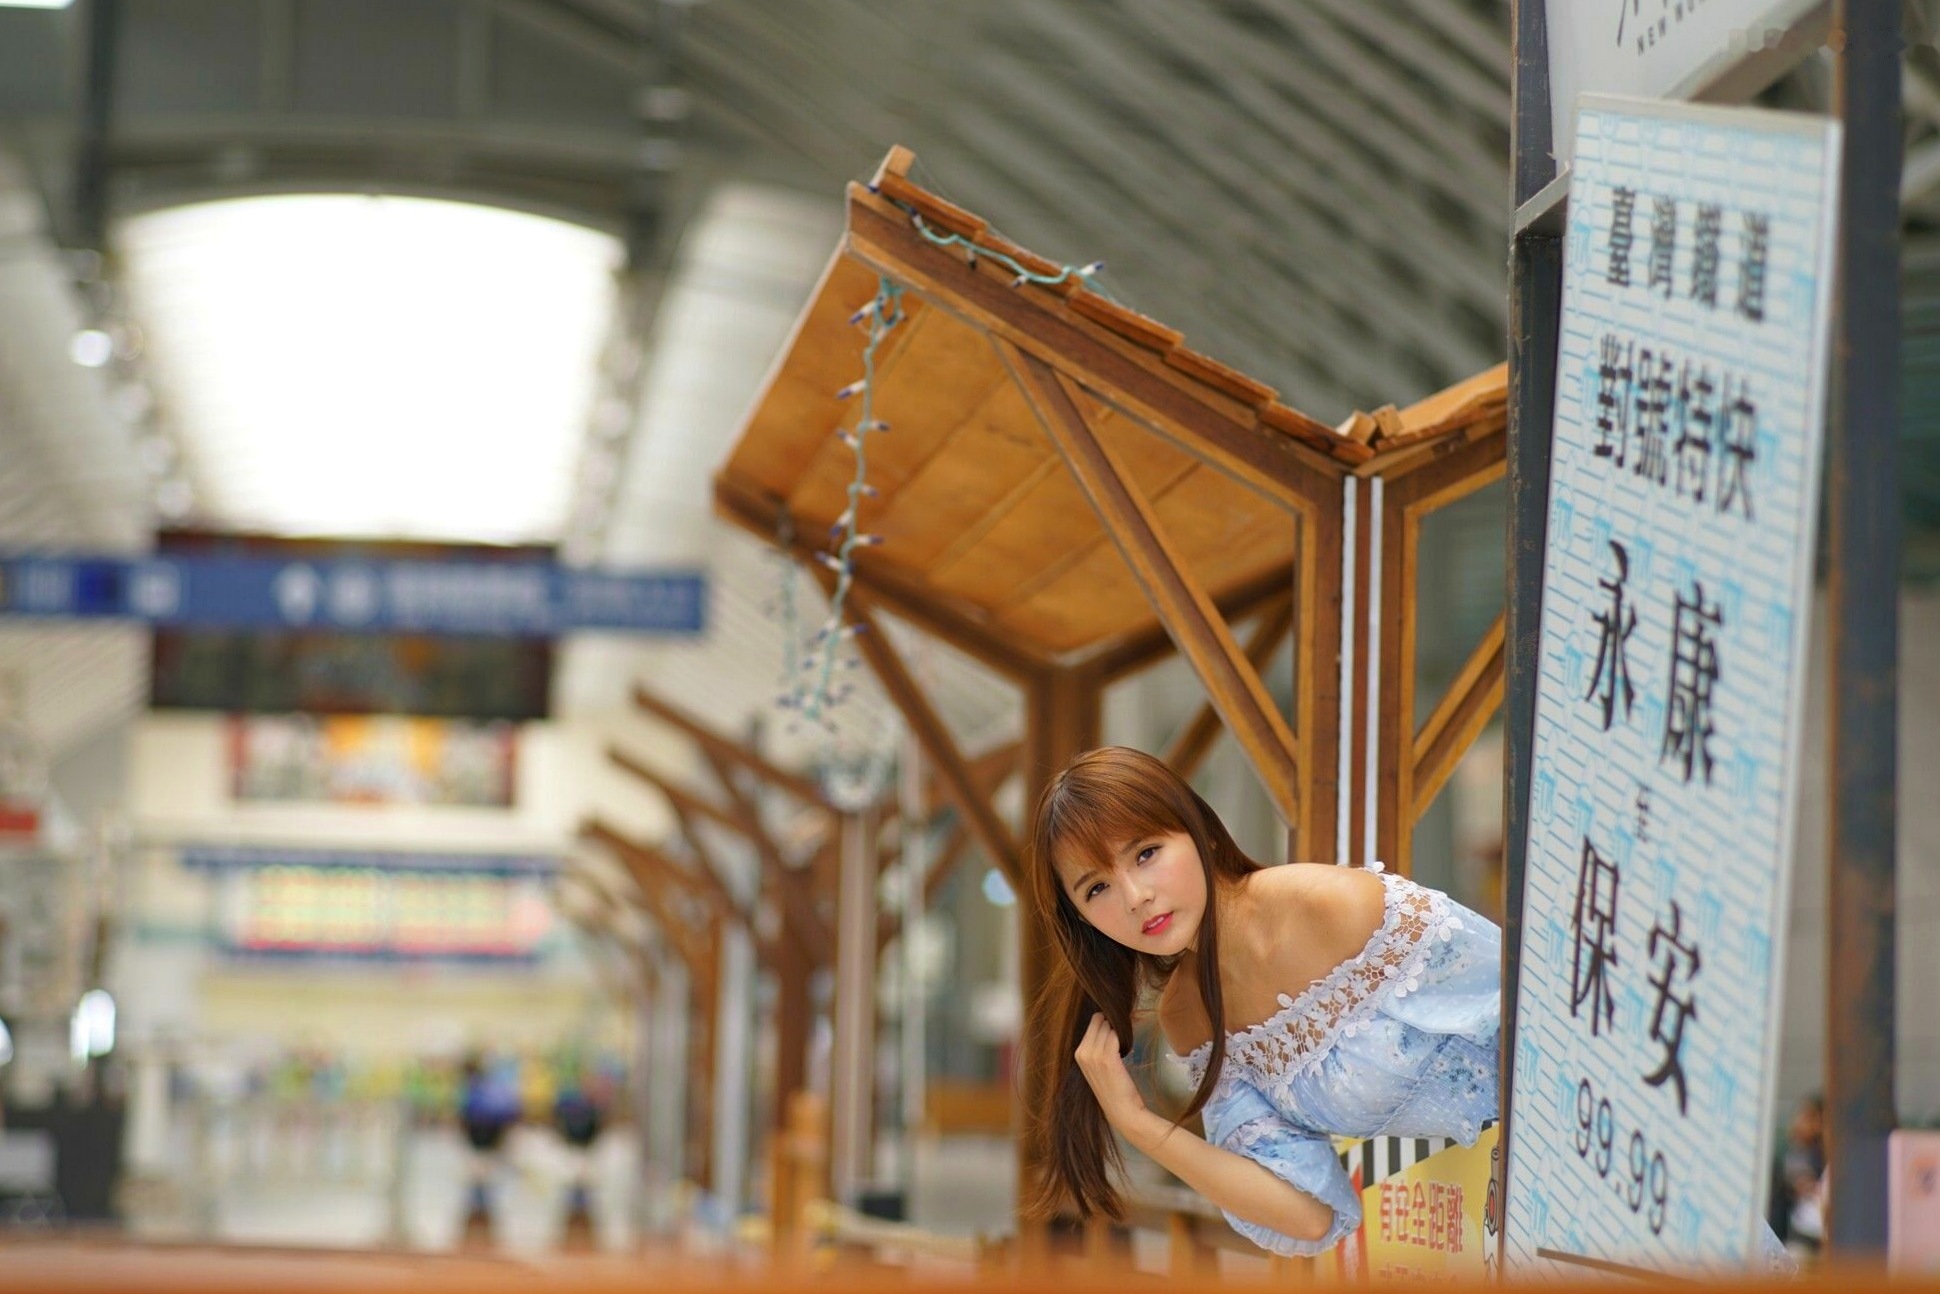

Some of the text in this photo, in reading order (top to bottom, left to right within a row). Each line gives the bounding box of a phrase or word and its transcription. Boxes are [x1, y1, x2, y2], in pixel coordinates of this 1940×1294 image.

[1636, 15, 1667, 57] NEW
[1594, 333, 1757, 523] 對號特快
[1584, 539, 1724, 786] 永康
[1570, 834, 1700, 1118] 保安
[1575, 1077, 1669, 1236] 99.99
